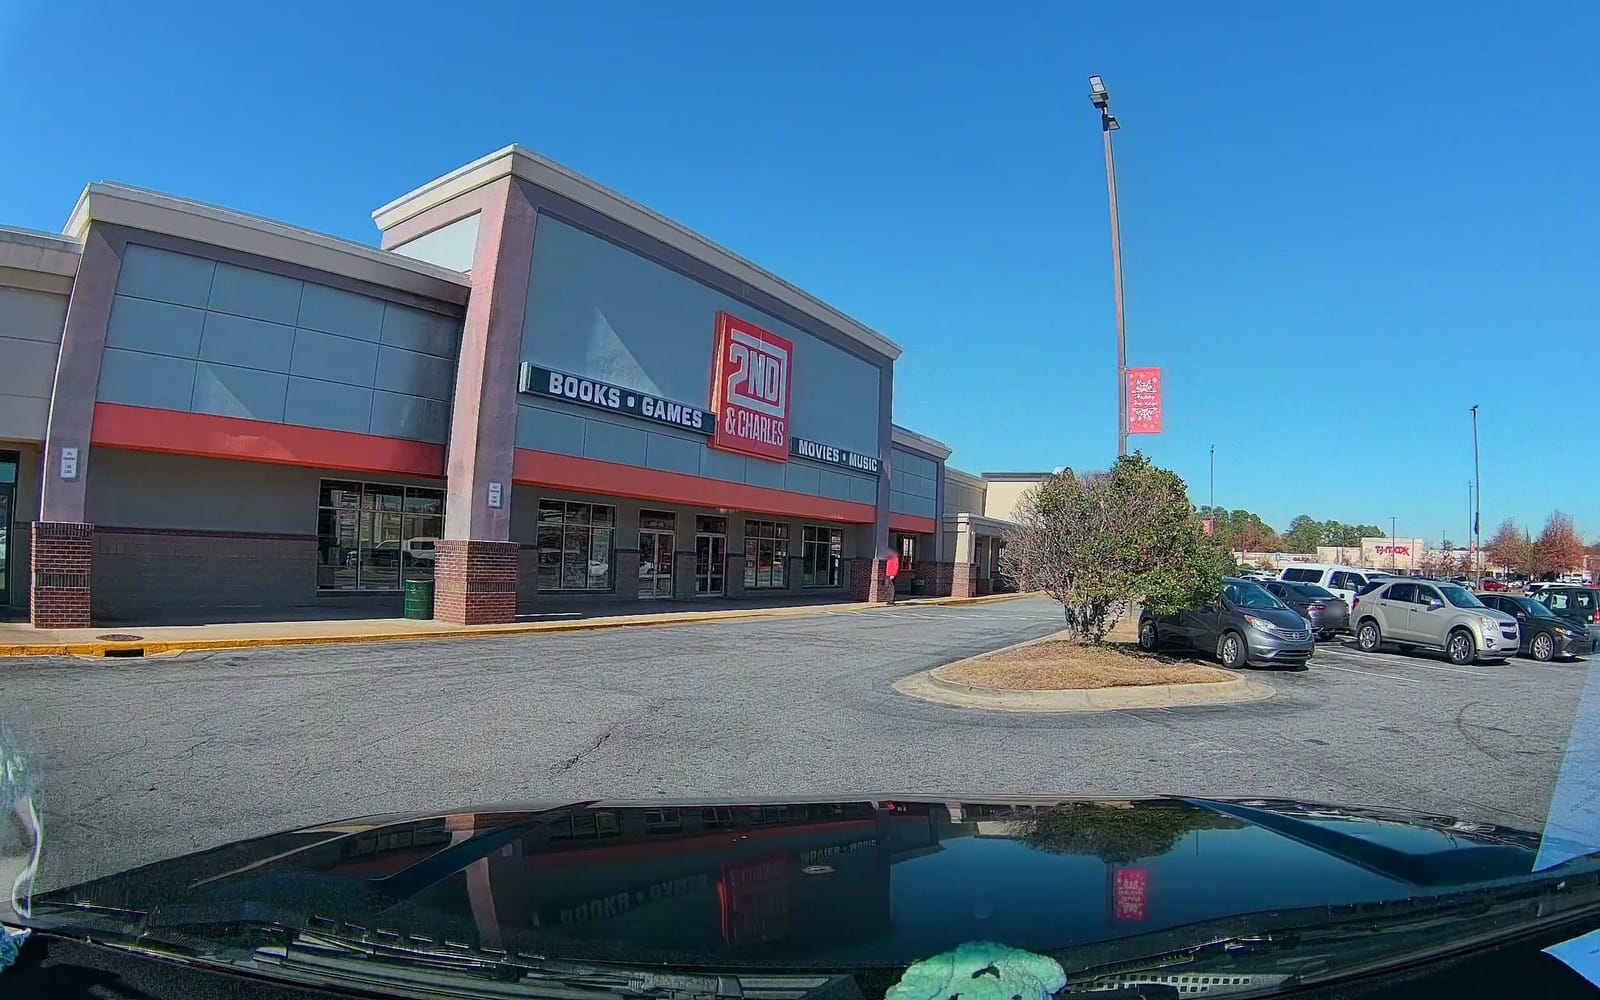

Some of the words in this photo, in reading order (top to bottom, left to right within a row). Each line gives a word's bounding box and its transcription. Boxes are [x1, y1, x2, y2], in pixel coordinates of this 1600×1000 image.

[727, 328, 787, 418] 2ND
[549, 372, 621, 409] BOOKS
[641, 396, 703, 429] GAMES
[725, 407, 736, 436] &
[738, 410, 784, 447] CHARLES
[798, 439, 840, 462] MOVIES
[849, 452, 878, 472] MUSIC
